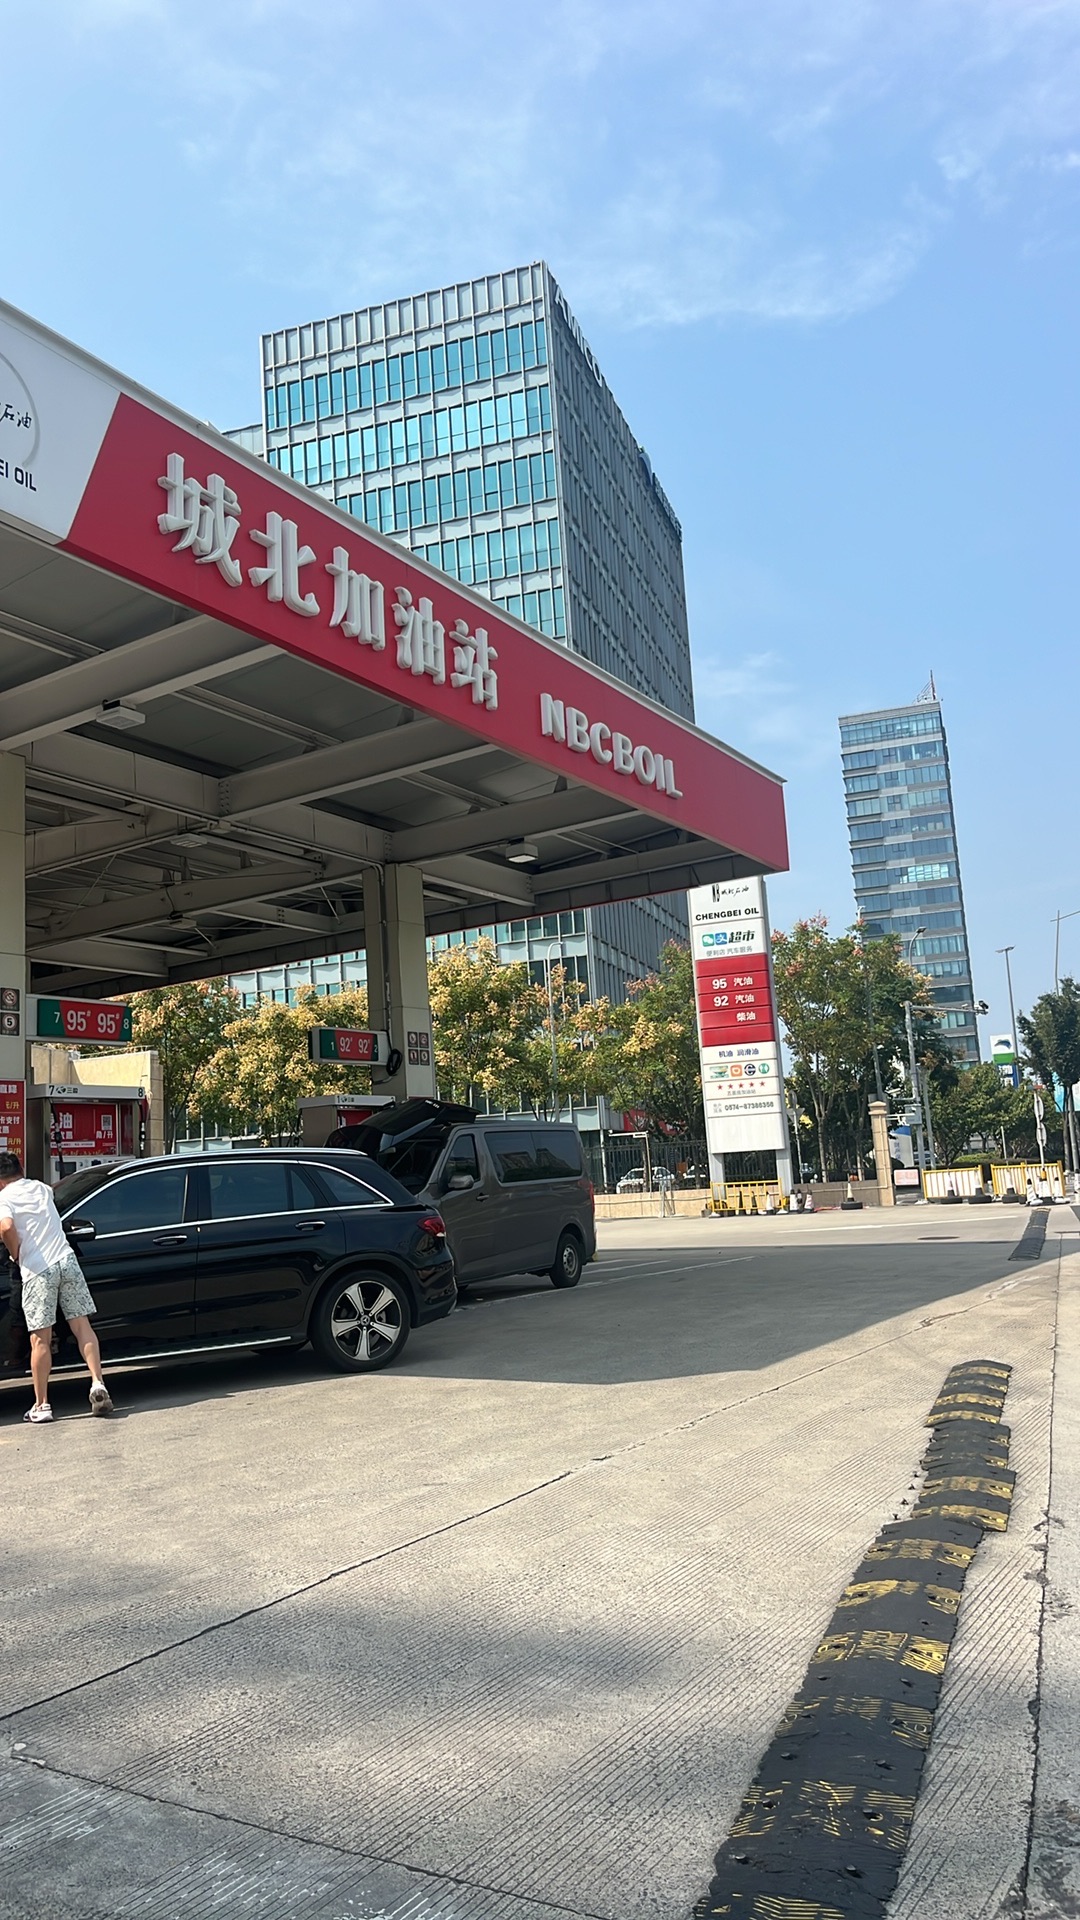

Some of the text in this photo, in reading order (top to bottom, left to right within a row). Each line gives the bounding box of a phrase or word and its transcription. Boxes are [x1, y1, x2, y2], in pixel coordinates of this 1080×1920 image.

[14, 466, 37, 492] OIL
[157, 452, 500, 712] 城北加油站
[540, 692, 683, 800] NBCBOIL
[695, 907, 759, 921] CHENGBEI OIL
[728, 930, 755, 943] 超市
[712, 976, 753, 990] 95 汽油
[713, 994, 755, 1007] 92 汽油
[7, 1017, 13, 1026] 5
[54, 1012, 60, 1023] 7
[123, 1018, 129, 1030] 8
[736, 1011, 756, 1022] 柴油
[49, 1085, 55, 1095] 7
[138, 1087, 144, 1097] 8
